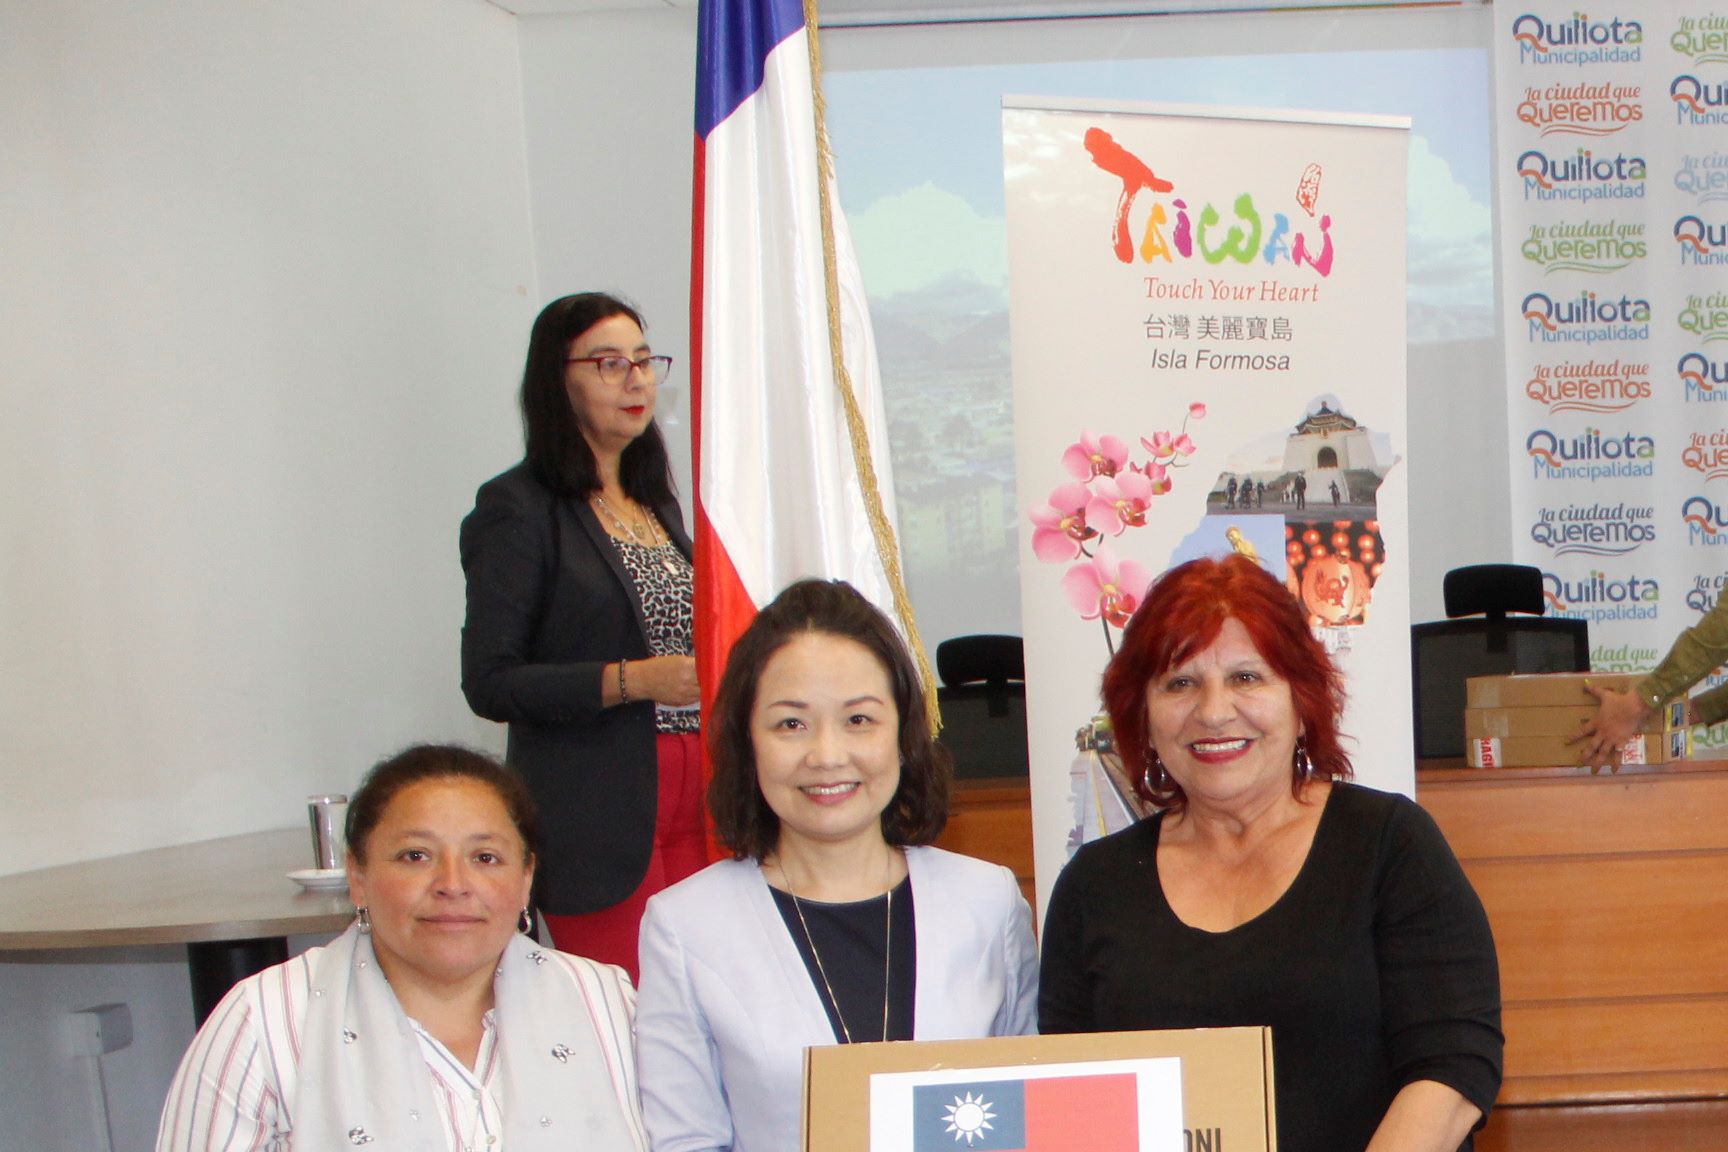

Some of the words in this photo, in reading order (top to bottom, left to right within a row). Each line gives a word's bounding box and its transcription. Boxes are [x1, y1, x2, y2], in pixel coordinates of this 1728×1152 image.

[1520, 35, 1641, 67] Municipalidad
[1545, 82, 1611, 102] ciudad
[1613, 85, 1640, 102] que
[1524, 171, 1645, 203] Municipalidad
[1549, 220, 1615, 240] ciudad
[1617, 223, 1644, 240] que
[1144, 277, 1203, 300] Touch
[1208, 279, 1256, 301] Your
[1259, 280, 1319, 302] Heart
[1143, 314, 1191, 340] 台灣
[1197, 315, 1293, 342] 美麗寶島
[1528, 313, 1649, 345] Municipalidad
[1151, 349, 1188, 370] Isla
[1195, 350, 1291, 371] Formosa
[1554, 360, 1619, 380] ciudad
[1621, 363, 1647, 380] que
[1534, 449, 1652, 481] Municipalidad
[1559, 503, 1624, 523] ciudad
[1626, 506, 1652, 523] que
[1630, 648, 1658, 664] que
